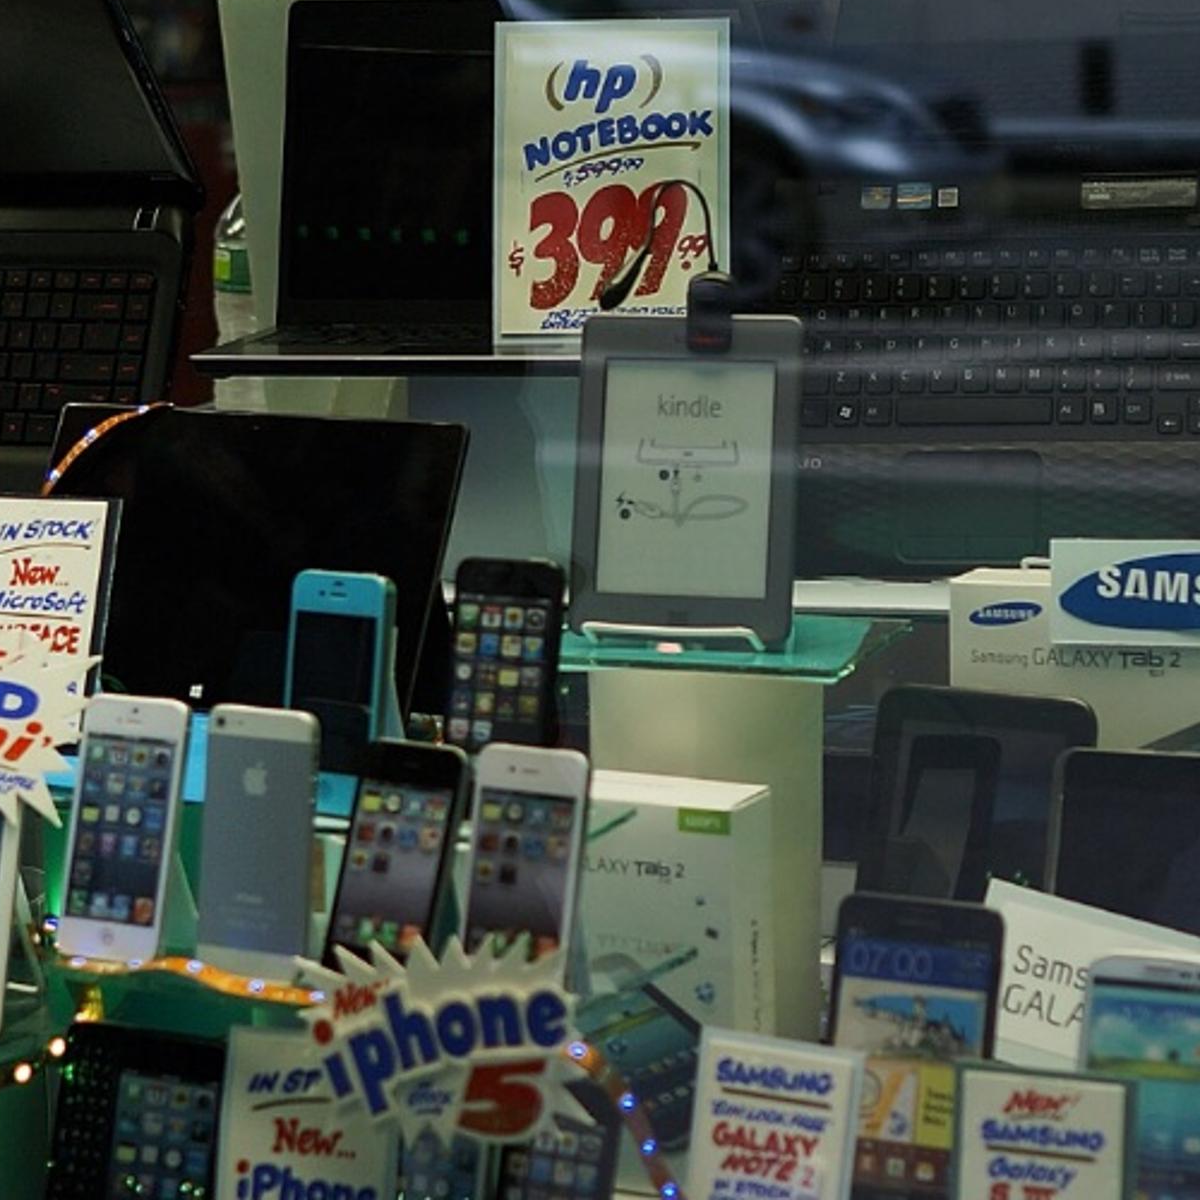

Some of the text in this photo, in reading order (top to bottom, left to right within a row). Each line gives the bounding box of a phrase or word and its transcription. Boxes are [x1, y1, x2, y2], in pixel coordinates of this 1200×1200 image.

[522, 109, 715, 171] NOTEBOOK
[657, 394, 723, 418] kindle
[1096, 564, 1200, 604] SAM
[978, 608, 1034, 620] SAMSUNG
[970, 647, 1182, 669] Samsung GALAXY Tab 2
[634, 860, 671, 878] Tab
[675, 863, 685, 879] 2
[248, 1071, 280, 1094] IN
[716, 1057, 834, 1095] SAMSUNG
[457, 1058, 548, 1137] 5
[712, 1121, 819, 1158] GALAXY
[981, 1119, 1105, 1151] SAMSUNG
[721, 1153, 799, 1183] NOTE
[988, 1156, 1078, 1189] Galaxy
